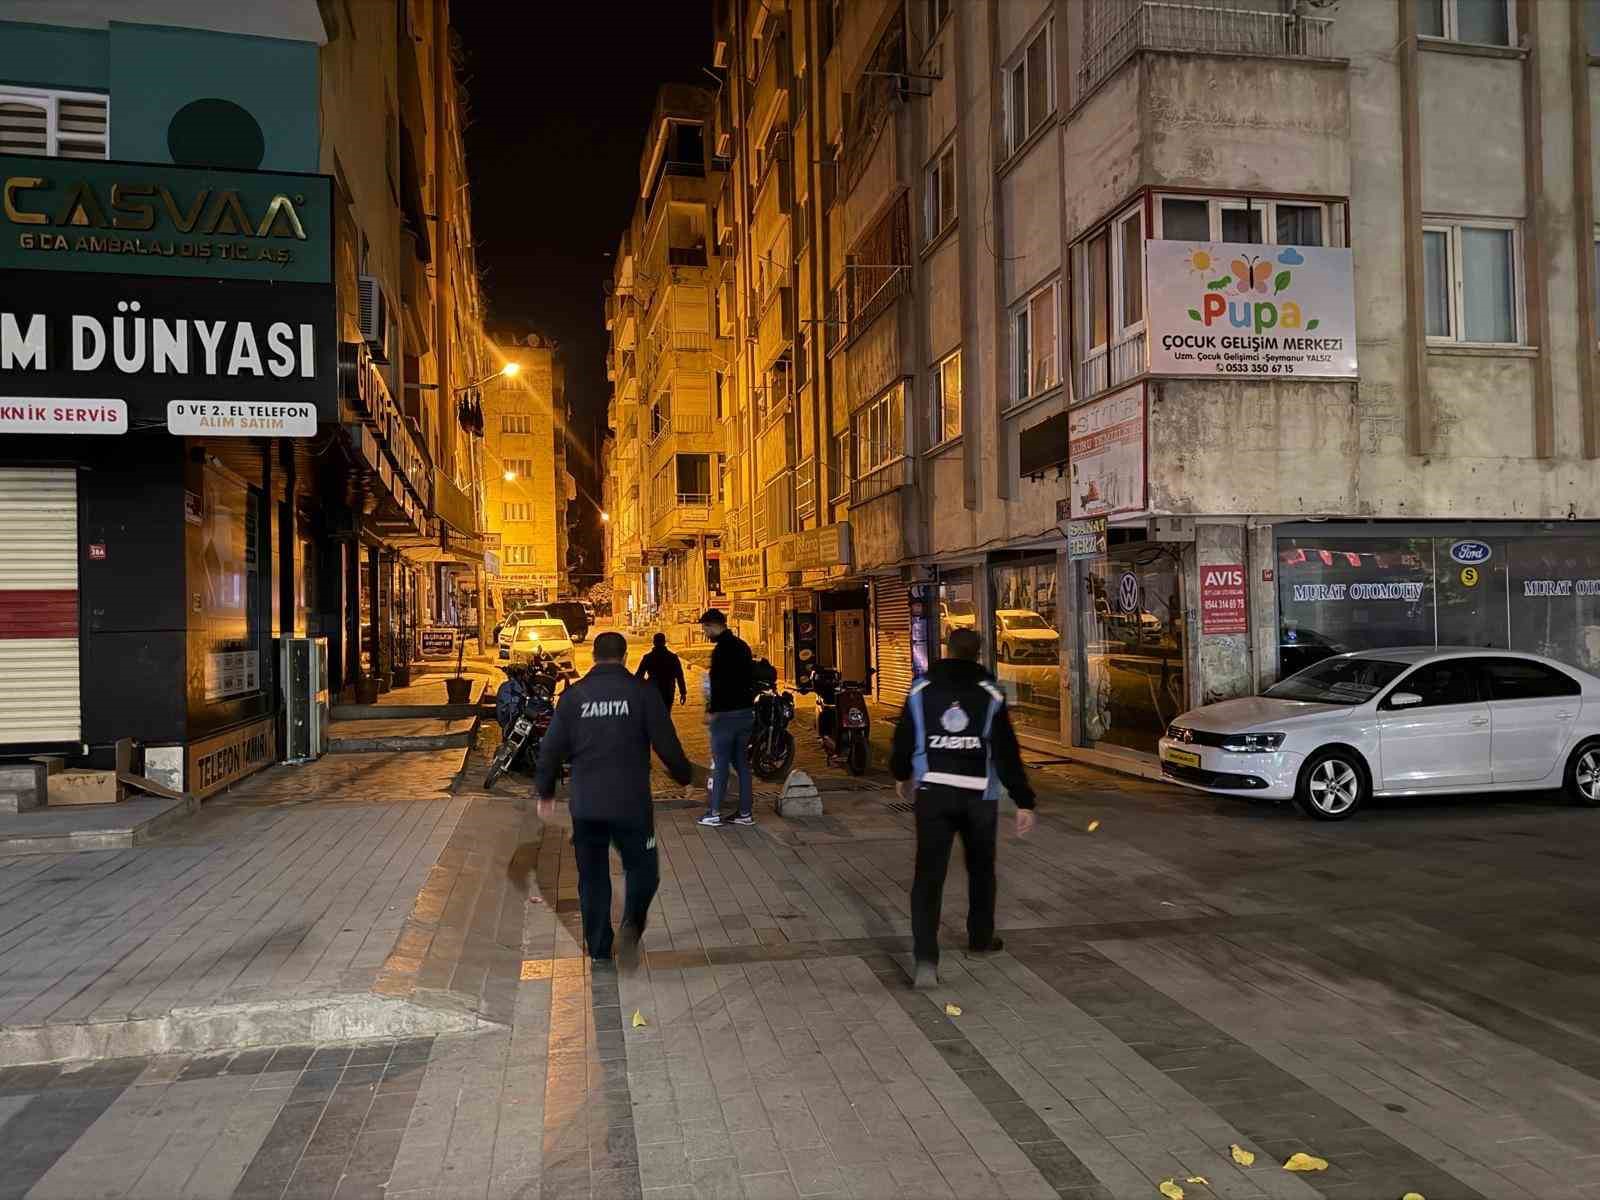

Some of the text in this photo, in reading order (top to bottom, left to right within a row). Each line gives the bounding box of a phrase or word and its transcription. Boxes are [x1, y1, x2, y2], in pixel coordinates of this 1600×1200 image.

[1203, 293, 1303, 335] Pupa
[1, 300, 315, 378] M DÜNYASI
[1162, 335, 1343, 353] ÇOCUK GELİŞİM MERKEZİ
[1174, 352, 1195, 361] Uzm.
[1197, 352, 1221, 362] Çocuk
[1223, 352, 1260, 363] Gelişimci
[1225, 363, 1294, 373] 0533 350 67 15
[53, 405, 118, 423] SERVİS
[190, 404, 207, 416] VE
[212, 405, 225, 417] 2.
[229, 405, 244, 417] EL
[248, 406, 309, 418] TELEFON
[199, 415, 285, 430] ALIM SATIM
[1457, 543, 1484, 559] Ford
[1204, 570, 1242, 586] AVIS
[1294, 583, 1346, 600] MURAT
[1524, 580, 1572, 597] MURAT
[581, 700, 630, 718] ZABITA
[928, 735, 981, 750] ZABITA
[199, 743, 240, 790] TELEFON
